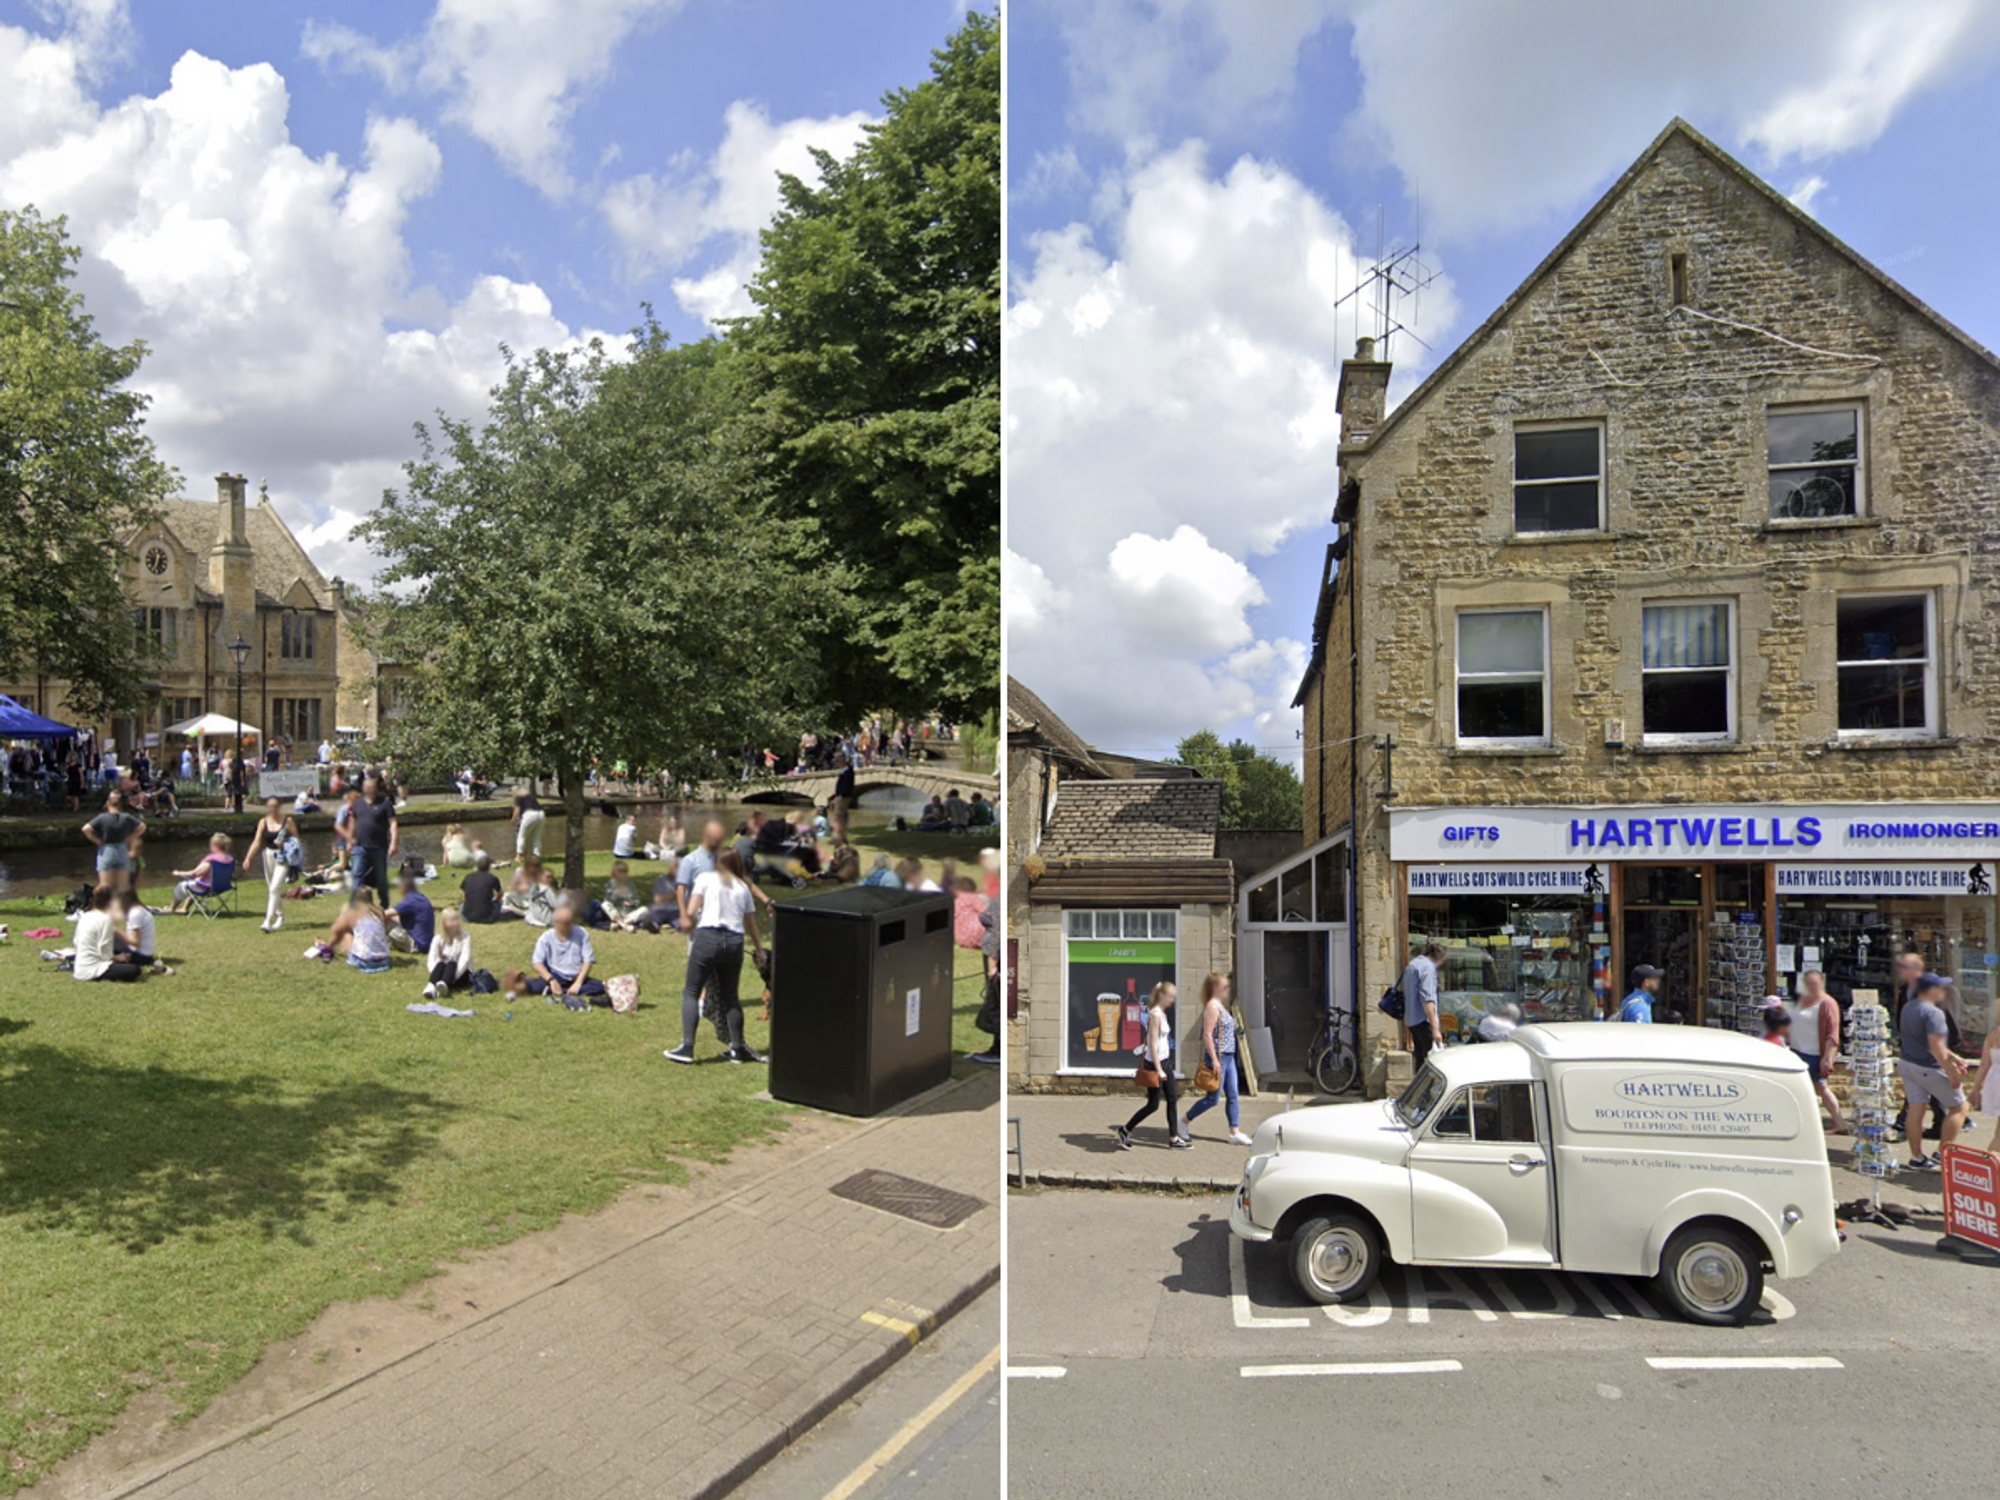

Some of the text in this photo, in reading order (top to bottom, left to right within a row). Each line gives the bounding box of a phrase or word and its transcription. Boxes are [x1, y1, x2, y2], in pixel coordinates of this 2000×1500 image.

[1443, 825, 1500, 842] GIFTS
[1571, 816, 1822, 847] HARTWELLS
[1411, 871, 1583, 888] HARTWELLS COTSWOLD CYCLE HIRE
[1778, 871, 1966, 886] HARTWELLS COTSWOLD CYCLE HIRE
[1104, 1013, 1114, 1043] BEER
[1624, 1082, 1740, 1098] HARTWELLS
[1595, 1108, 1773, 1123] BOURTON ON THE WATER
[1640, 1159, 1663, 1169] Cycle
[1953, 1192, 1997, 1218] SOLD
[1955, 1210, 2000, 1238] HERE
